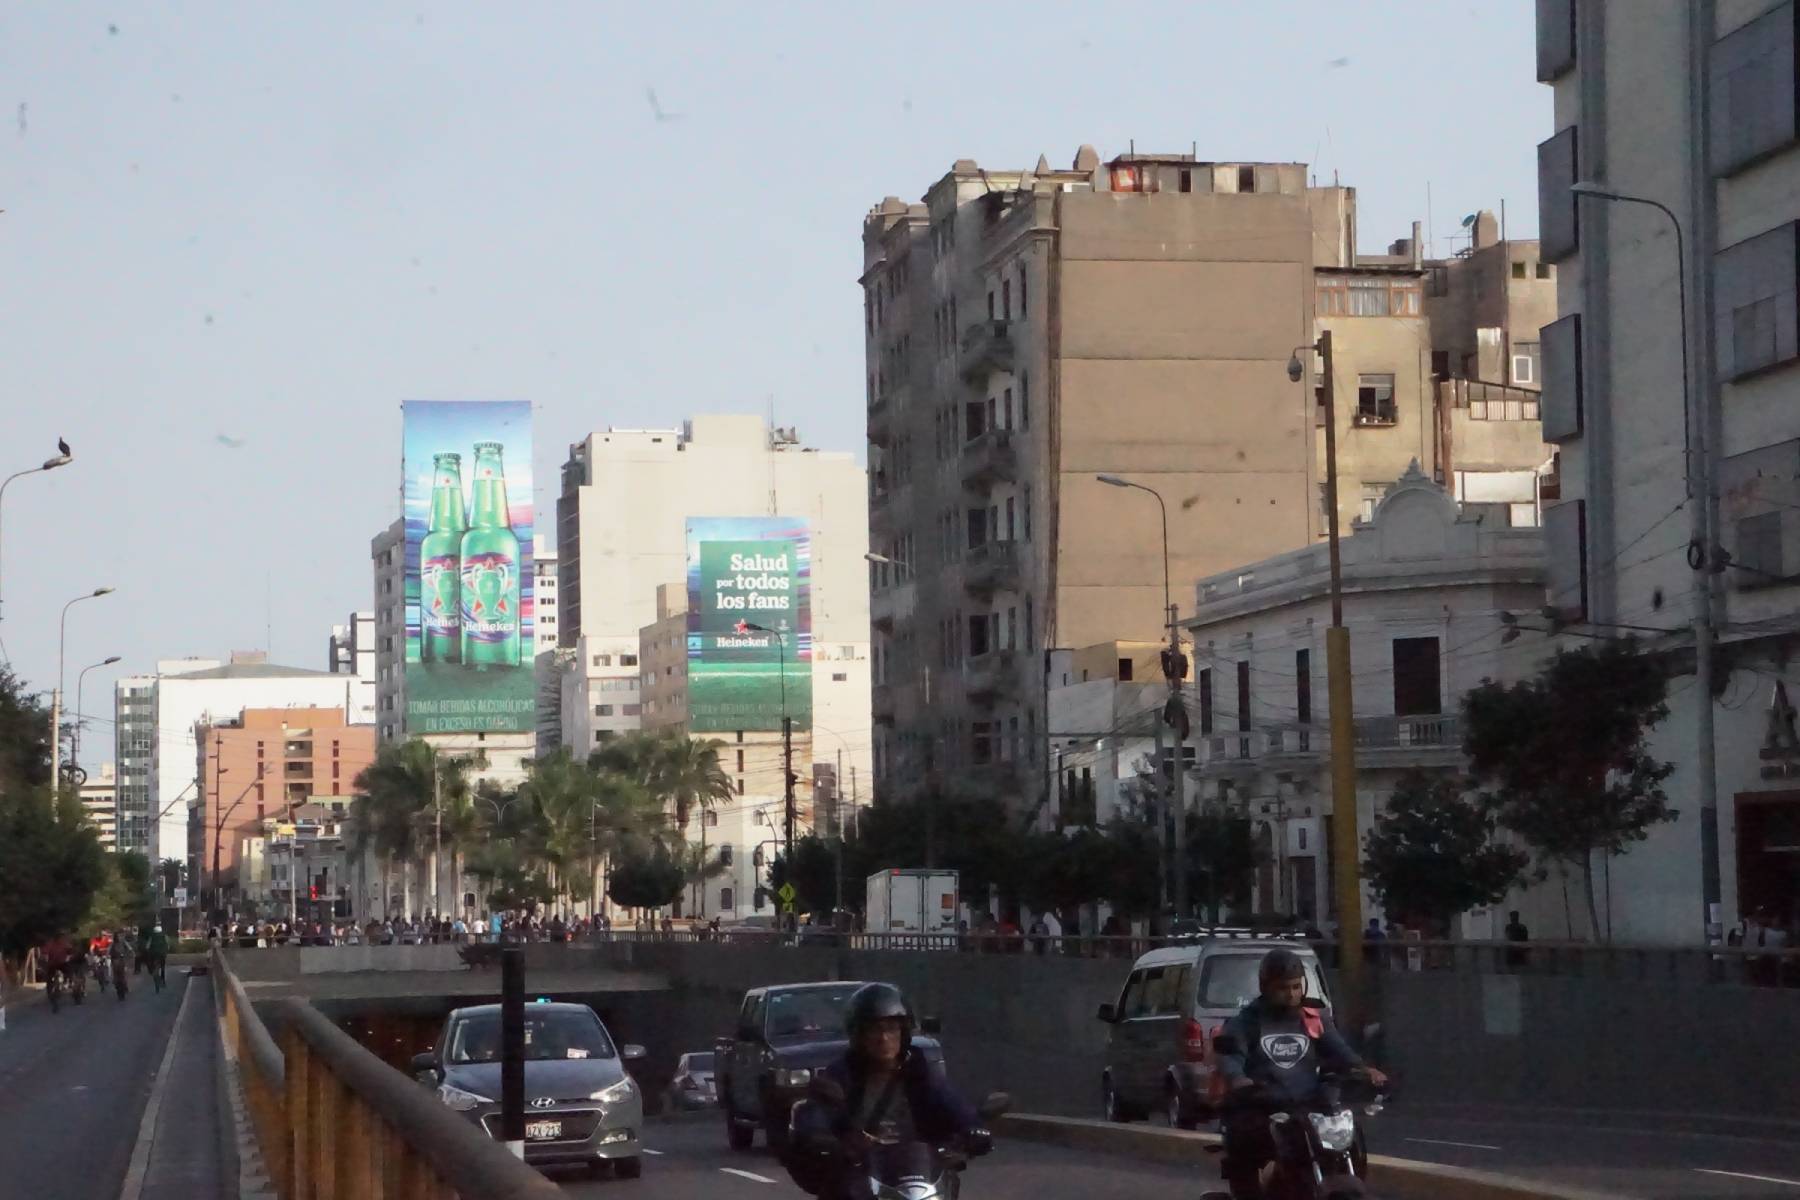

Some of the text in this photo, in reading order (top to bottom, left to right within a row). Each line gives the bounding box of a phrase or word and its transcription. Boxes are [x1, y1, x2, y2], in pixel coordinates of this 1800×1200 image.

[730, 553, 789, 571] Salud
[716, 573, 789, 590] por todos
[716, 592, 790, 609] los fans
[716, 636, 769, 648] Heineken
[408, 700, 438, 714] TOMAR
[440, 700, 476, 713] BEBIDAS
